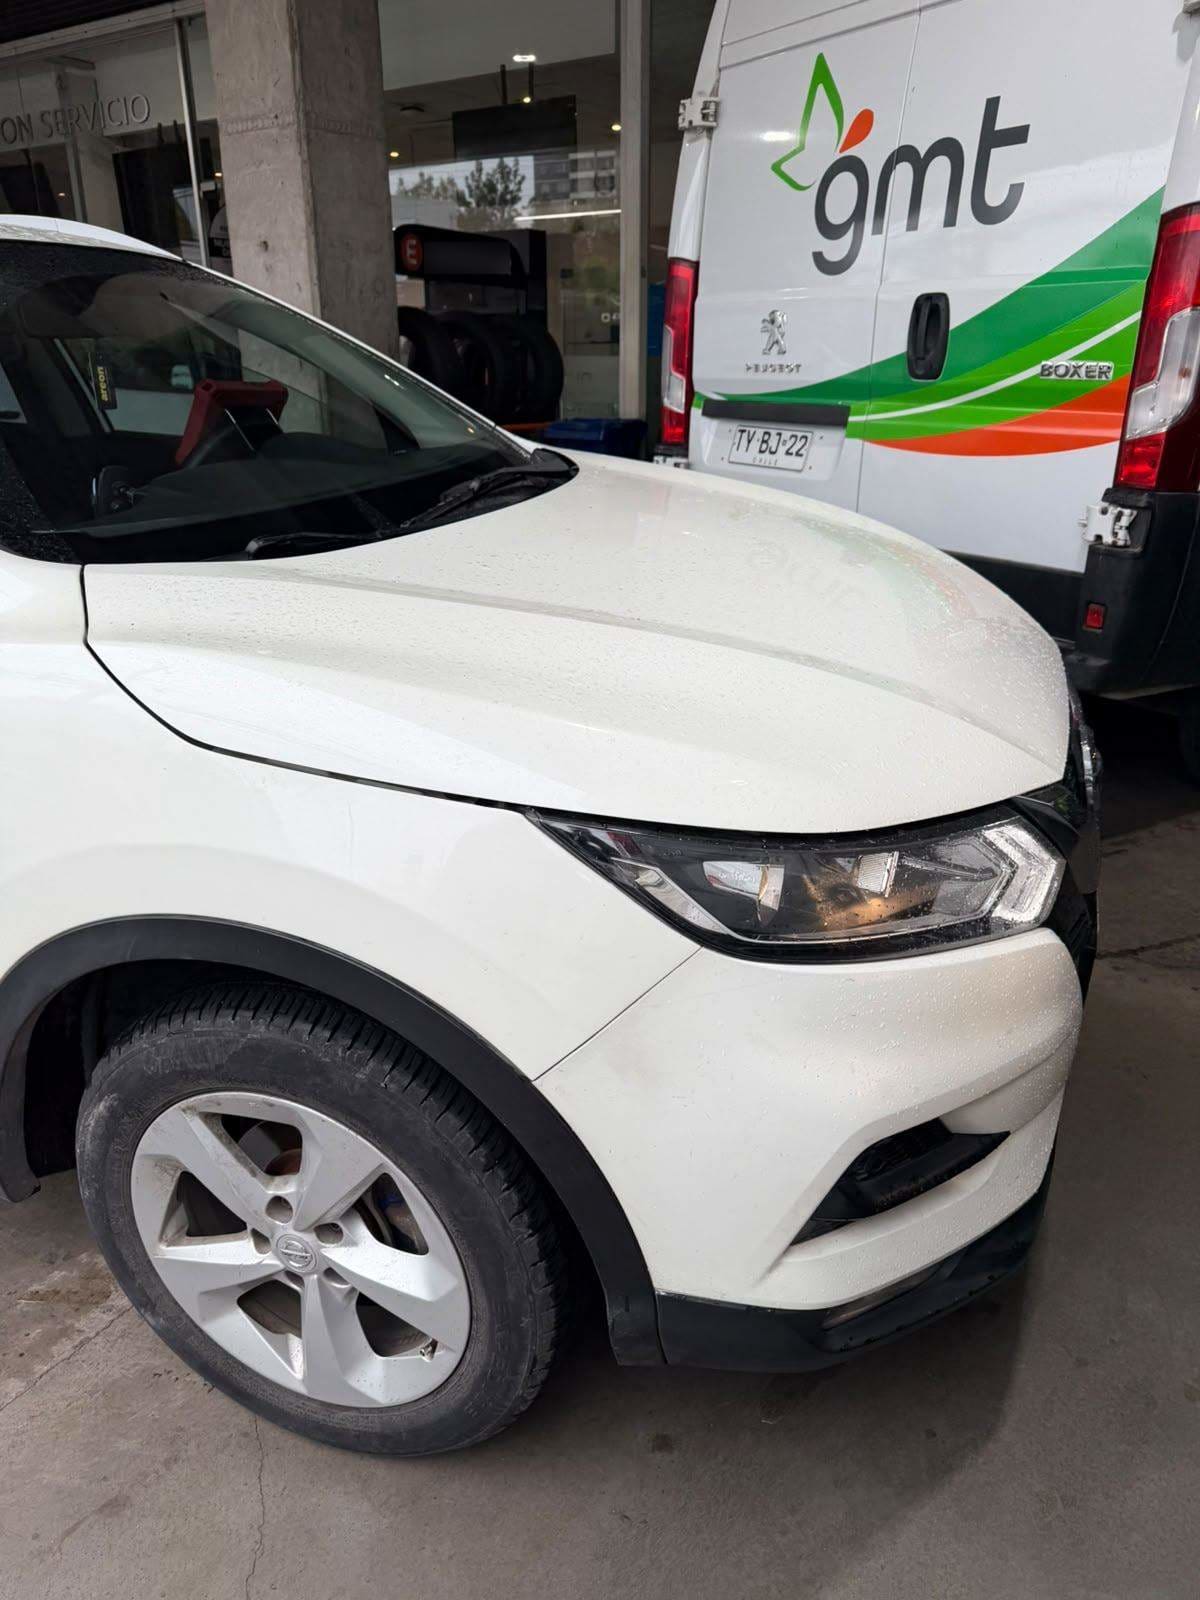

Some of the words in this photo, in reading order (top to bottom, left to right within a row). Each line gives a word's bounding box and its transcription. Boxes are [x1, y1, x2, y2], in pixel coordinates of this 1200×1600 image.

[40, 94, 150, 138] SERVICIO
[811, 95, 1030, 276] gmt
[1040, 360, 1114, 380] BOXER
